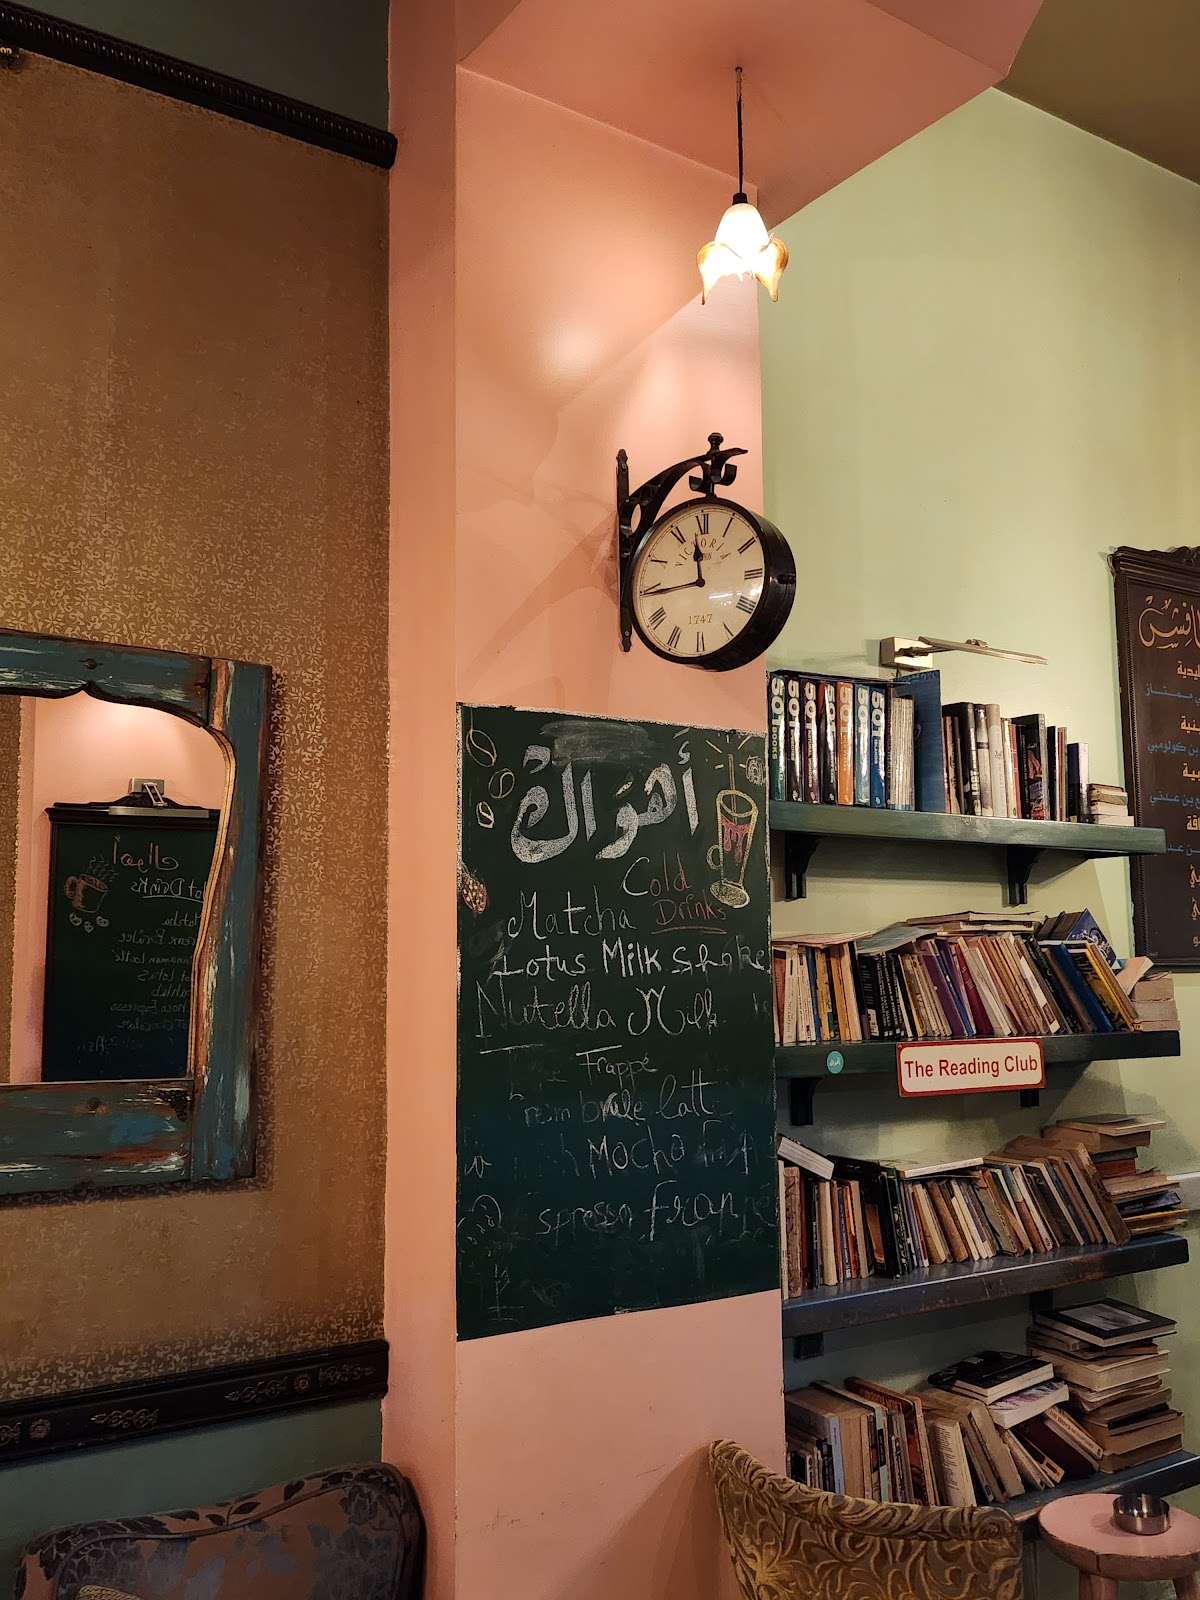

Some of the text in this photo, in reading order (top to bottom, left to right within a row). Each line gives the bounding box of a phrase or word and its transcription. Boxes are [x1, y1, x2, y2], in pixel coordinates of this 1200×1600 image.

[688, 613, 713, 625] 1747
[771, 677, 785, 727] 501
[788, 679, 799, 727] 501
[805, 681, 817, 729] 501
[827, 684, 836, 733] 501
[840, 686, 852, 734] 501
[857, 687, 869, 734] 501
[871, 690, 884, 738] 501
[1147, 740, 1187, 755] كولومبي
[622, 851, 692, 897] Cold
[507, 885, 637, 940] Matcha
[652, 891, 727, 926] Drinks
[492, 944, 586, 981] Lotus
[602, 937, 663, 978] Milk
[475, 976, 617, 1038] Nutella
[904, 1055, 1038, 1078] The Reading Club
